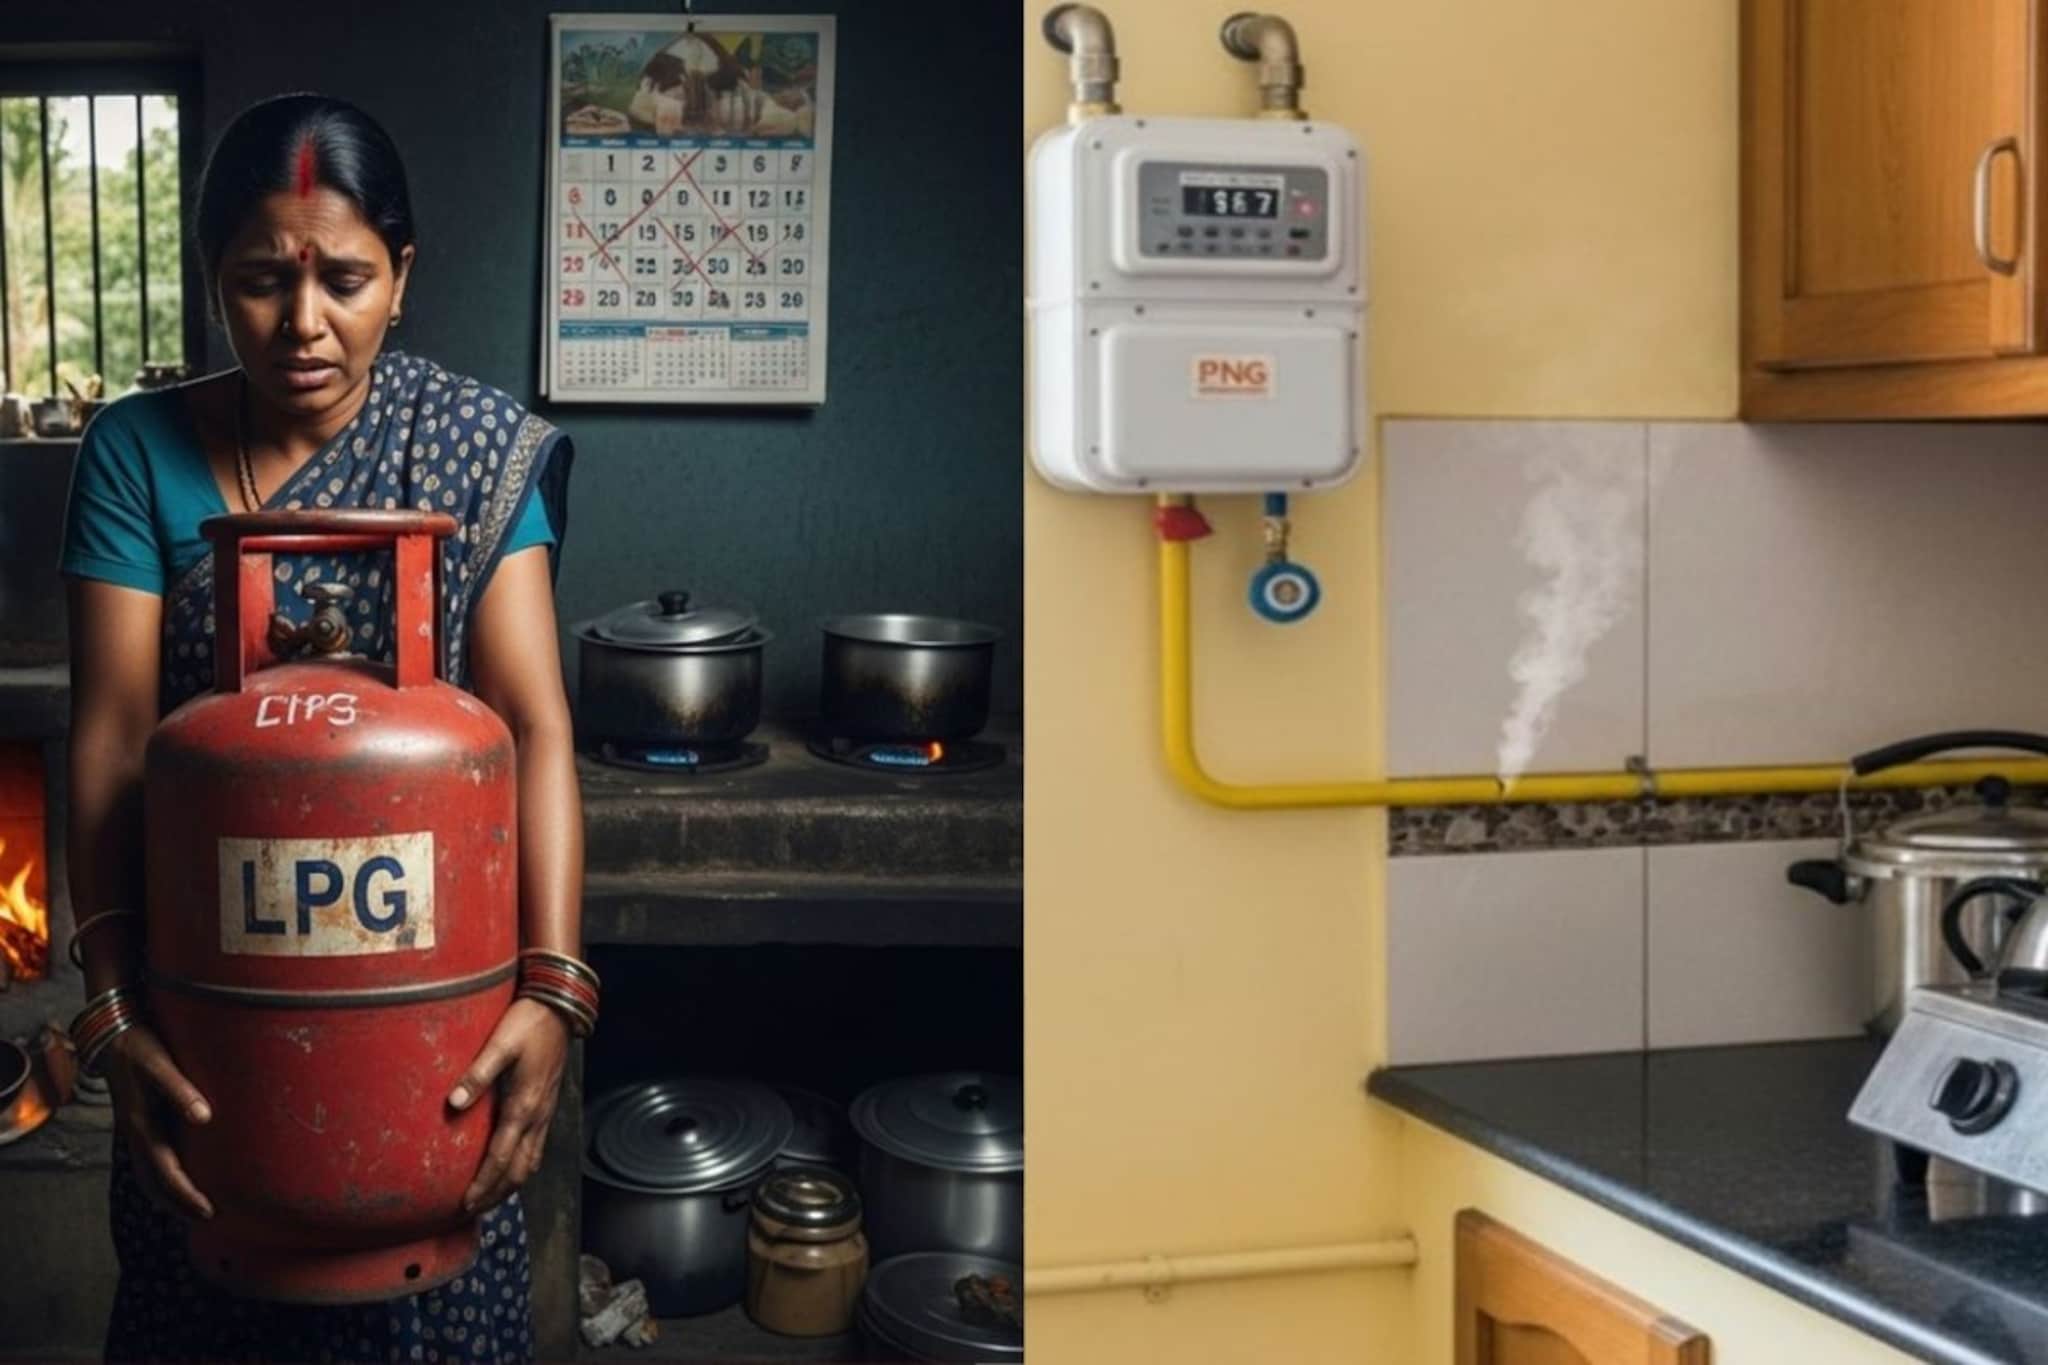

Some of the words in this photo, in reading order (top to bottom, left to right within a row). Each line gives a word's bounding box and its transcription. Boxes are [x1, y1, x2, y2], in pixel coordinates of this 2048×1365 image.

[607, 154, 615, 172] 1
[642, 155, 656, 172] 2
[753, 155, 766, 173] 6
[748, 190, 771, 208] 12
[1199, 360, 1267, 385] PNG
[242, 856, 407, 935] LPG
